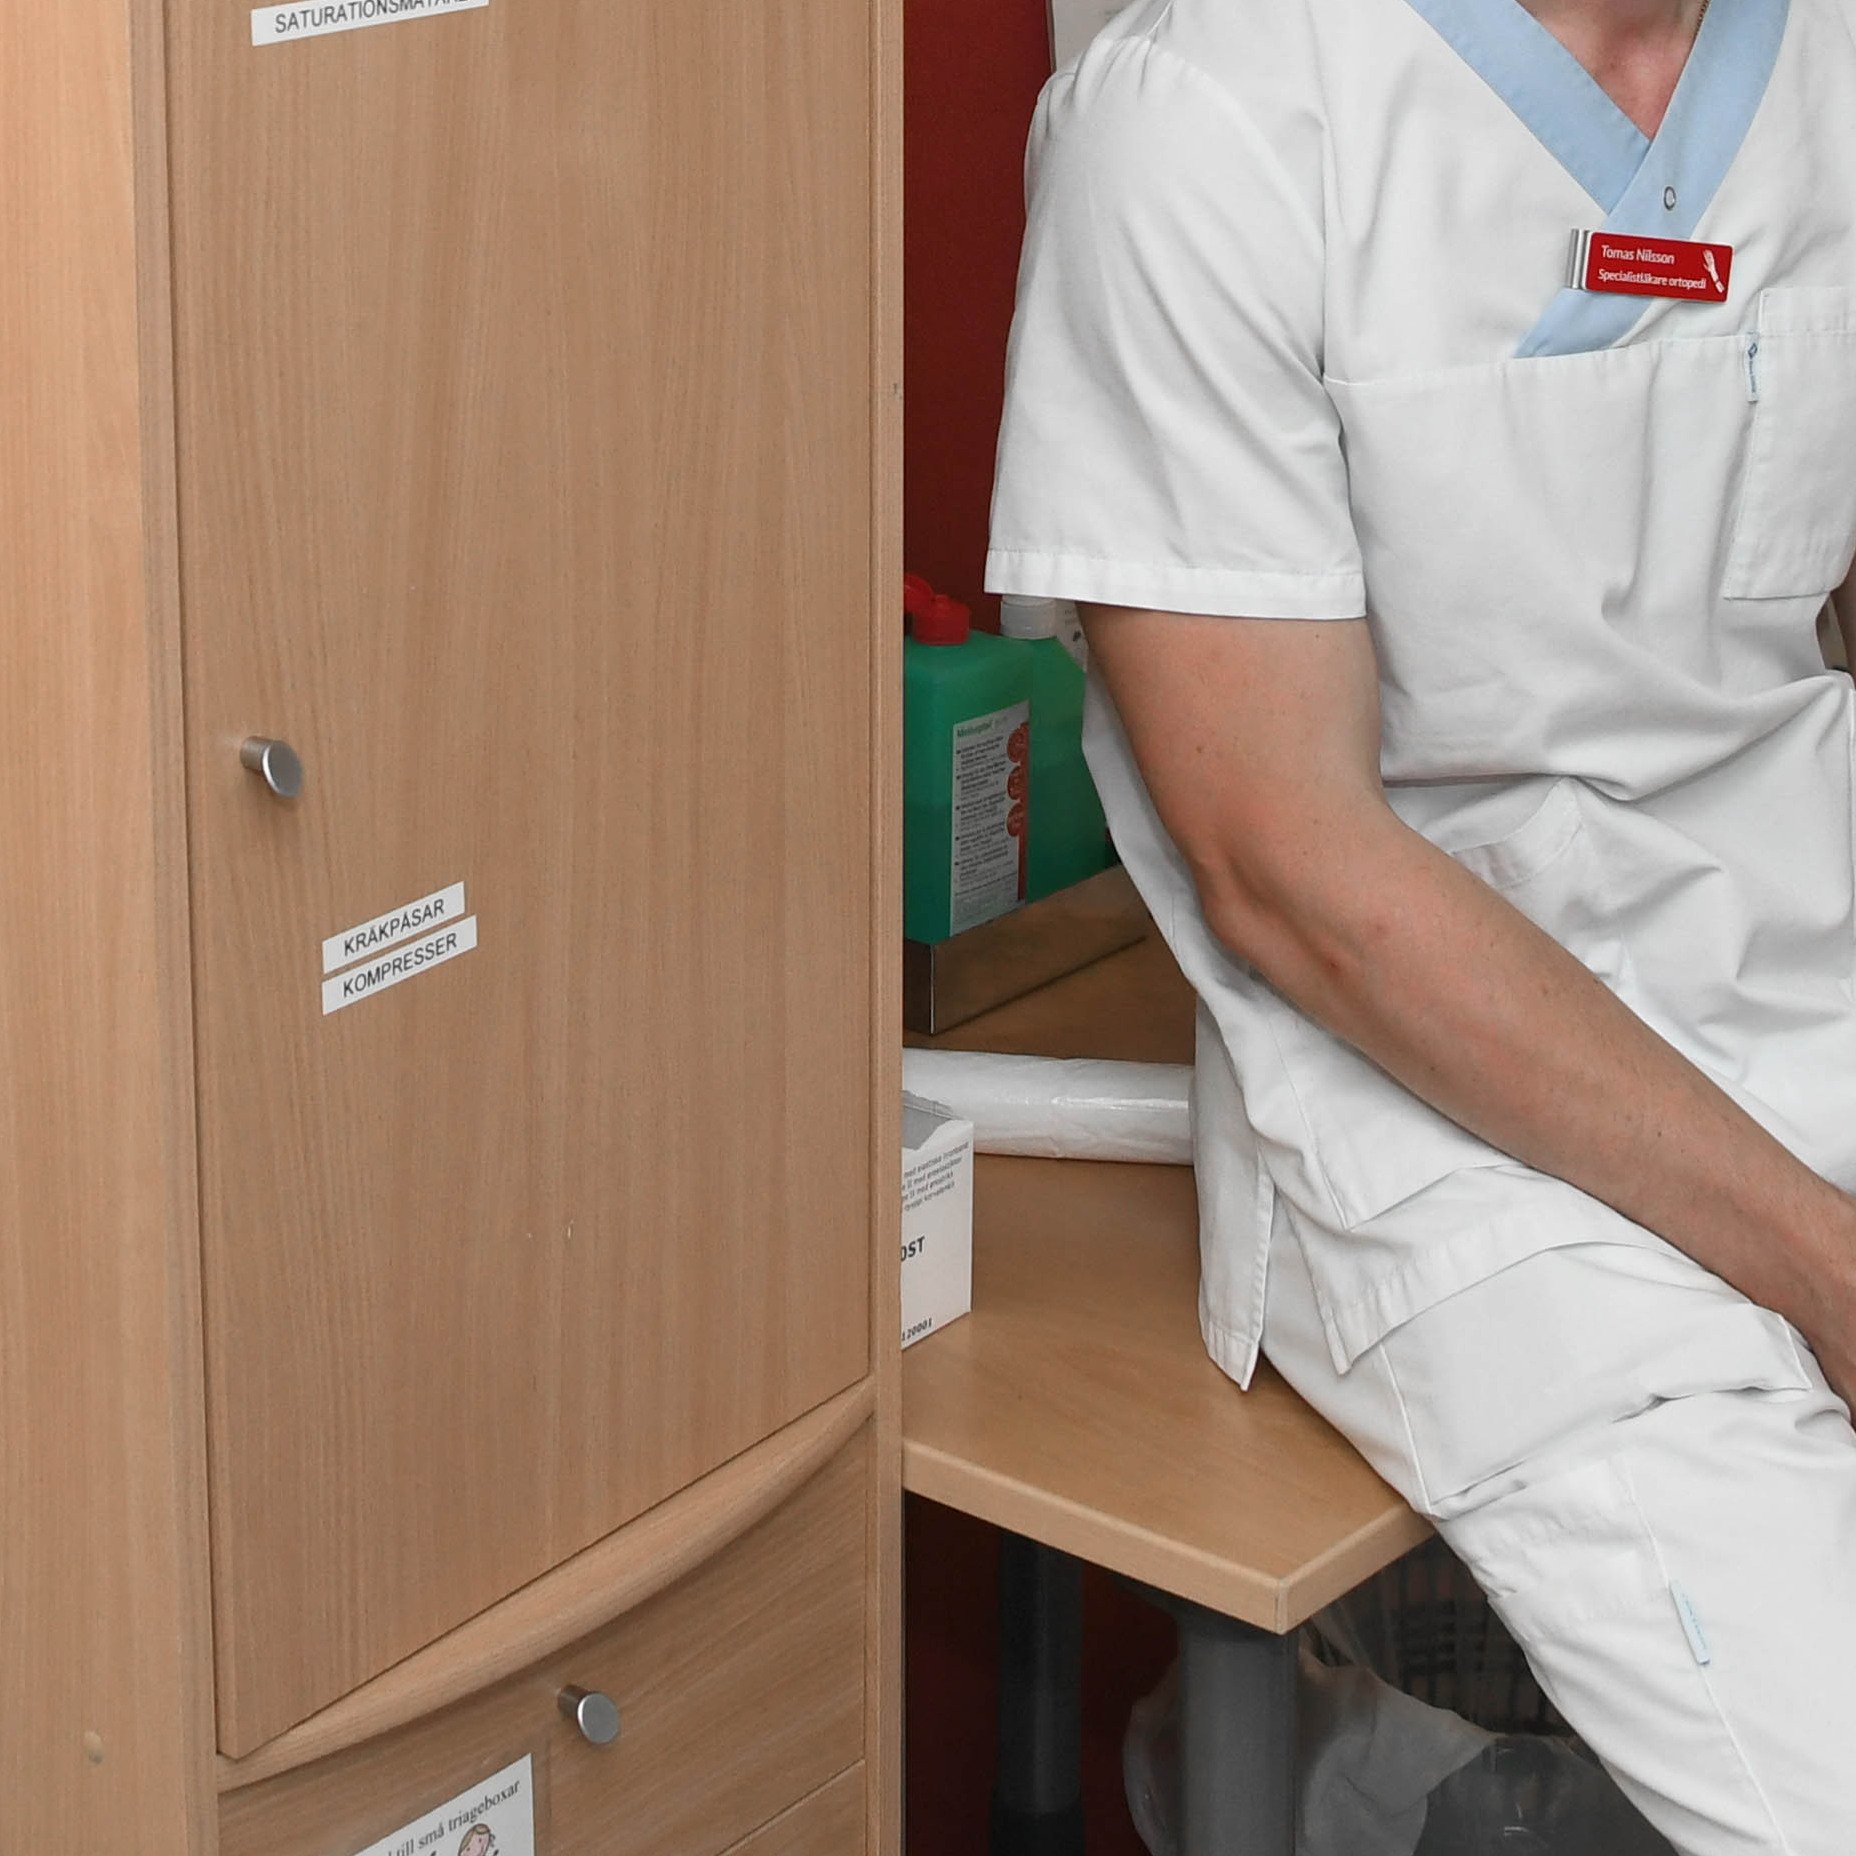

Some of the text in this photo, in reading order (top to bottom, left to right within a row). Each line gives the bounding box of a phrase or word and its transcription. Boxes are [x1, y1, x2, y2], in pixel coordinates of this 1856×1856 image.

[1601, 243, 1676, 265] Tomas Nilsson
[1668, 274, 1708, 290] ortopedi
[343, 931, 459, 999] KOMPRESSER
[418, 1822, 445, 1851] små
[447, 1780, 522, 1833] triageboxar
